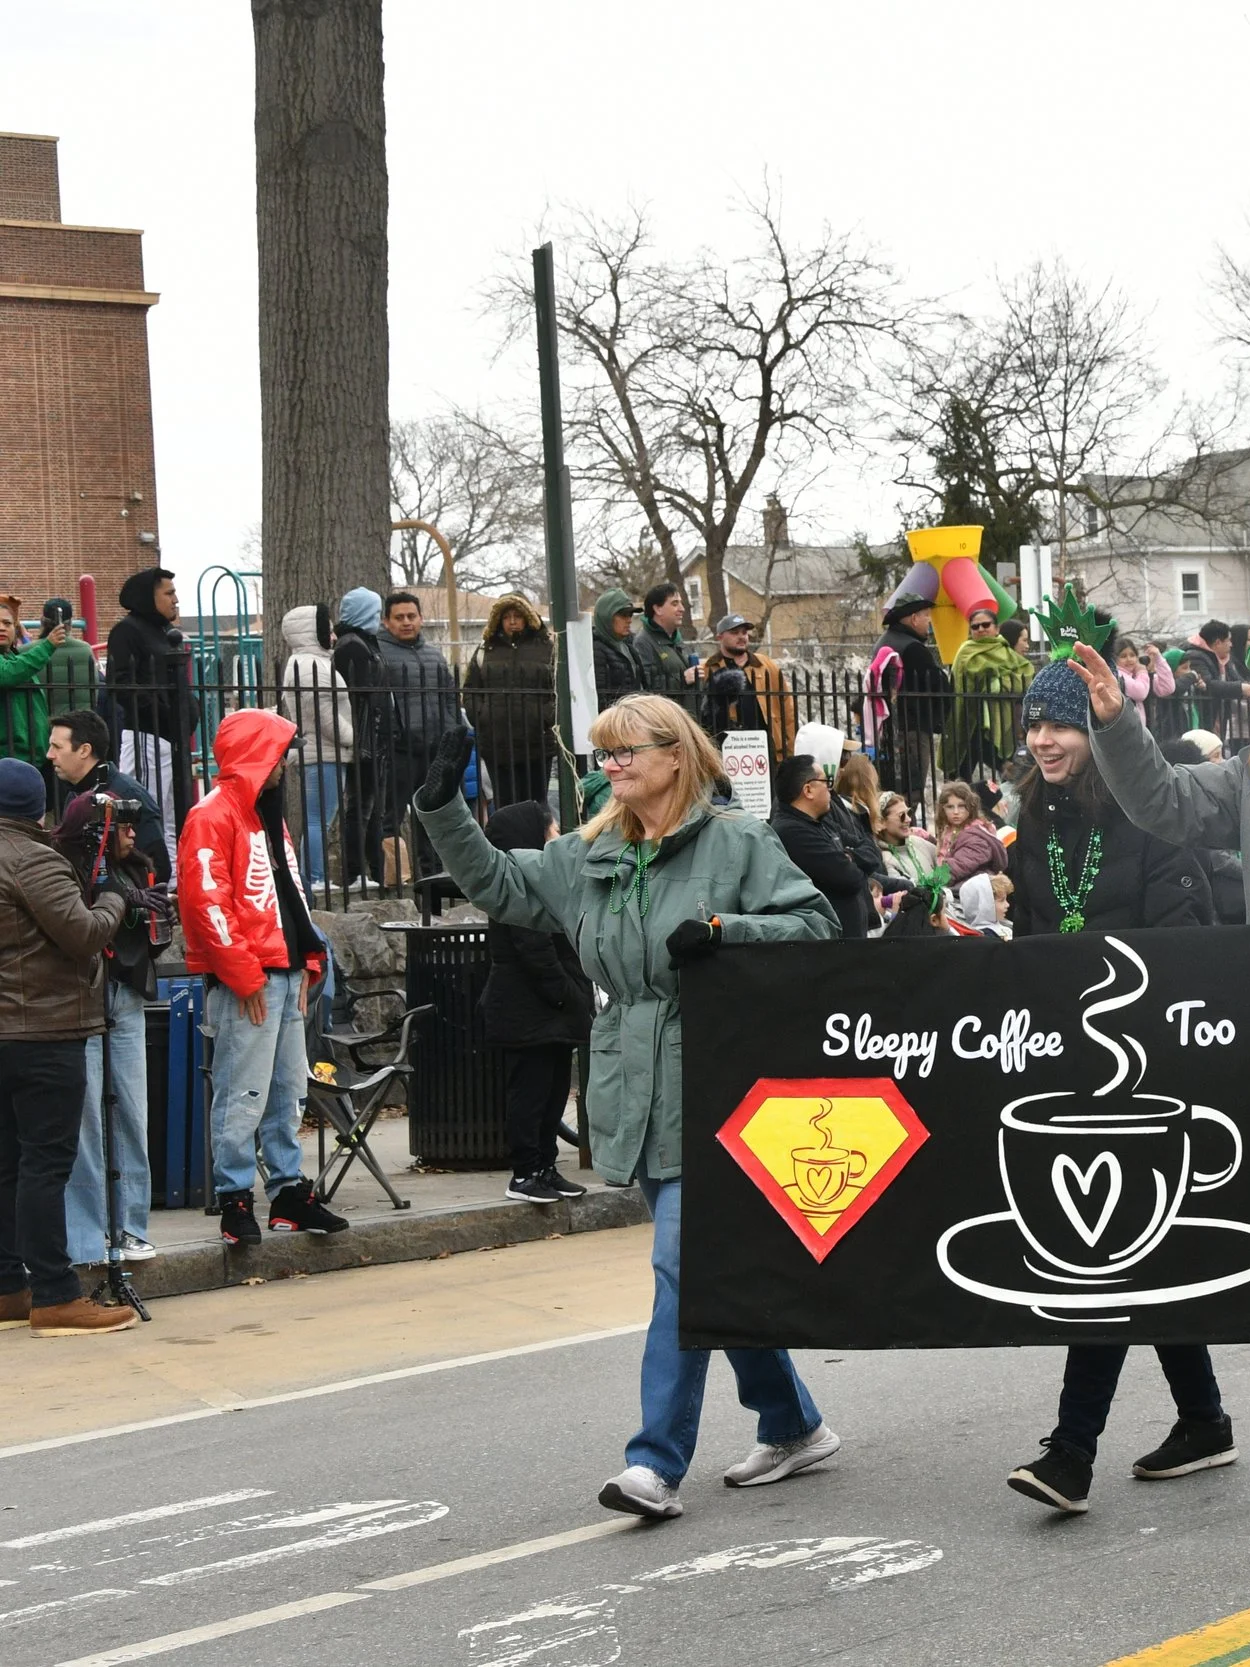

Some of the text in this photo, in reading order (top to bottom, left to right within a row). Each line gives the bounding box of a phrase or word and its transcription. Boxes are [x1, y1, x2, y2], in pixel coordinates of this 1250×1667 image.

[959, 542, 967, 550] 10
[823, 1000, 1236, 1079] Sleepy Coffee Too
